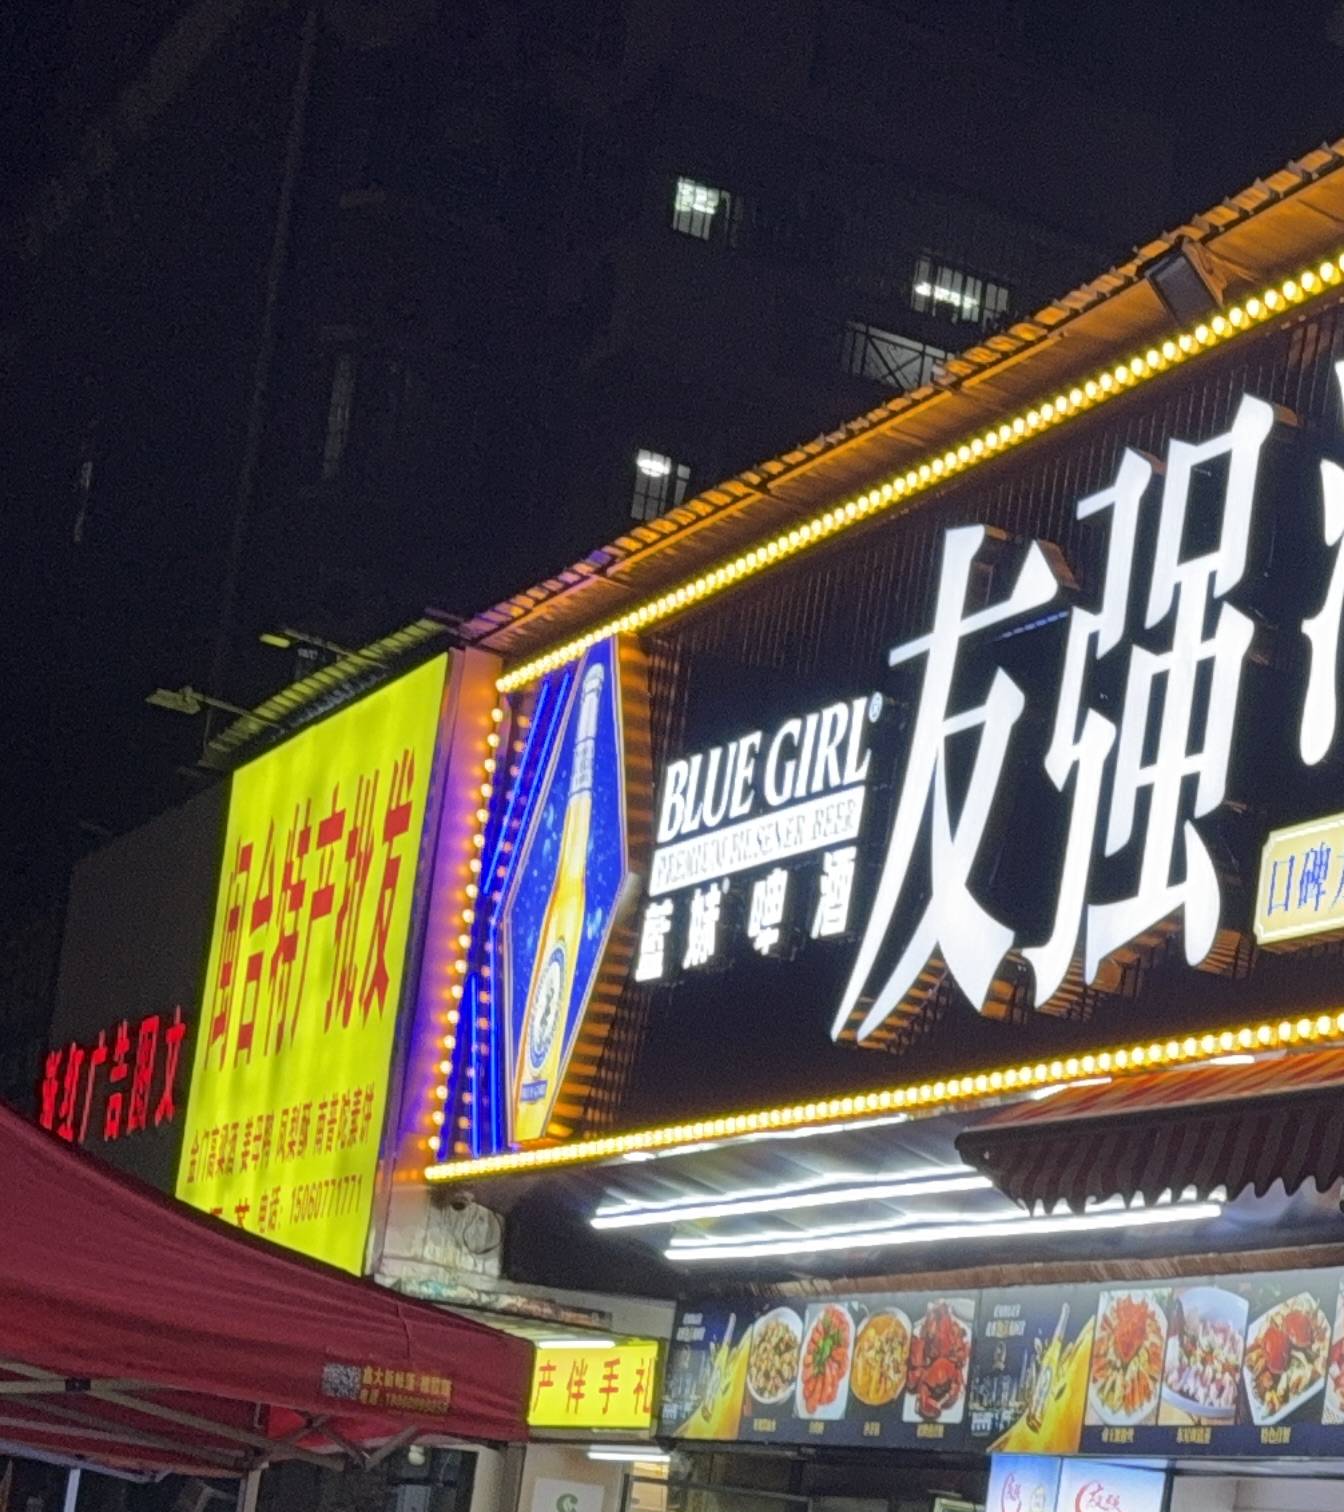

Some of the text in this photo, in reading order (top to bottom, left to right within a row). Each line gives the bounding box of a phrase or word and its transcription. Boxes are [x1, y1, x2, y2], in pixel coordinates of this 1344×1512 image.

[657, 697, 871, 842] BLUE GIRL
[203, 747, 415, 1072] 闽台特产批发
[533, 1358, 652, 1415] 产伴手礼
